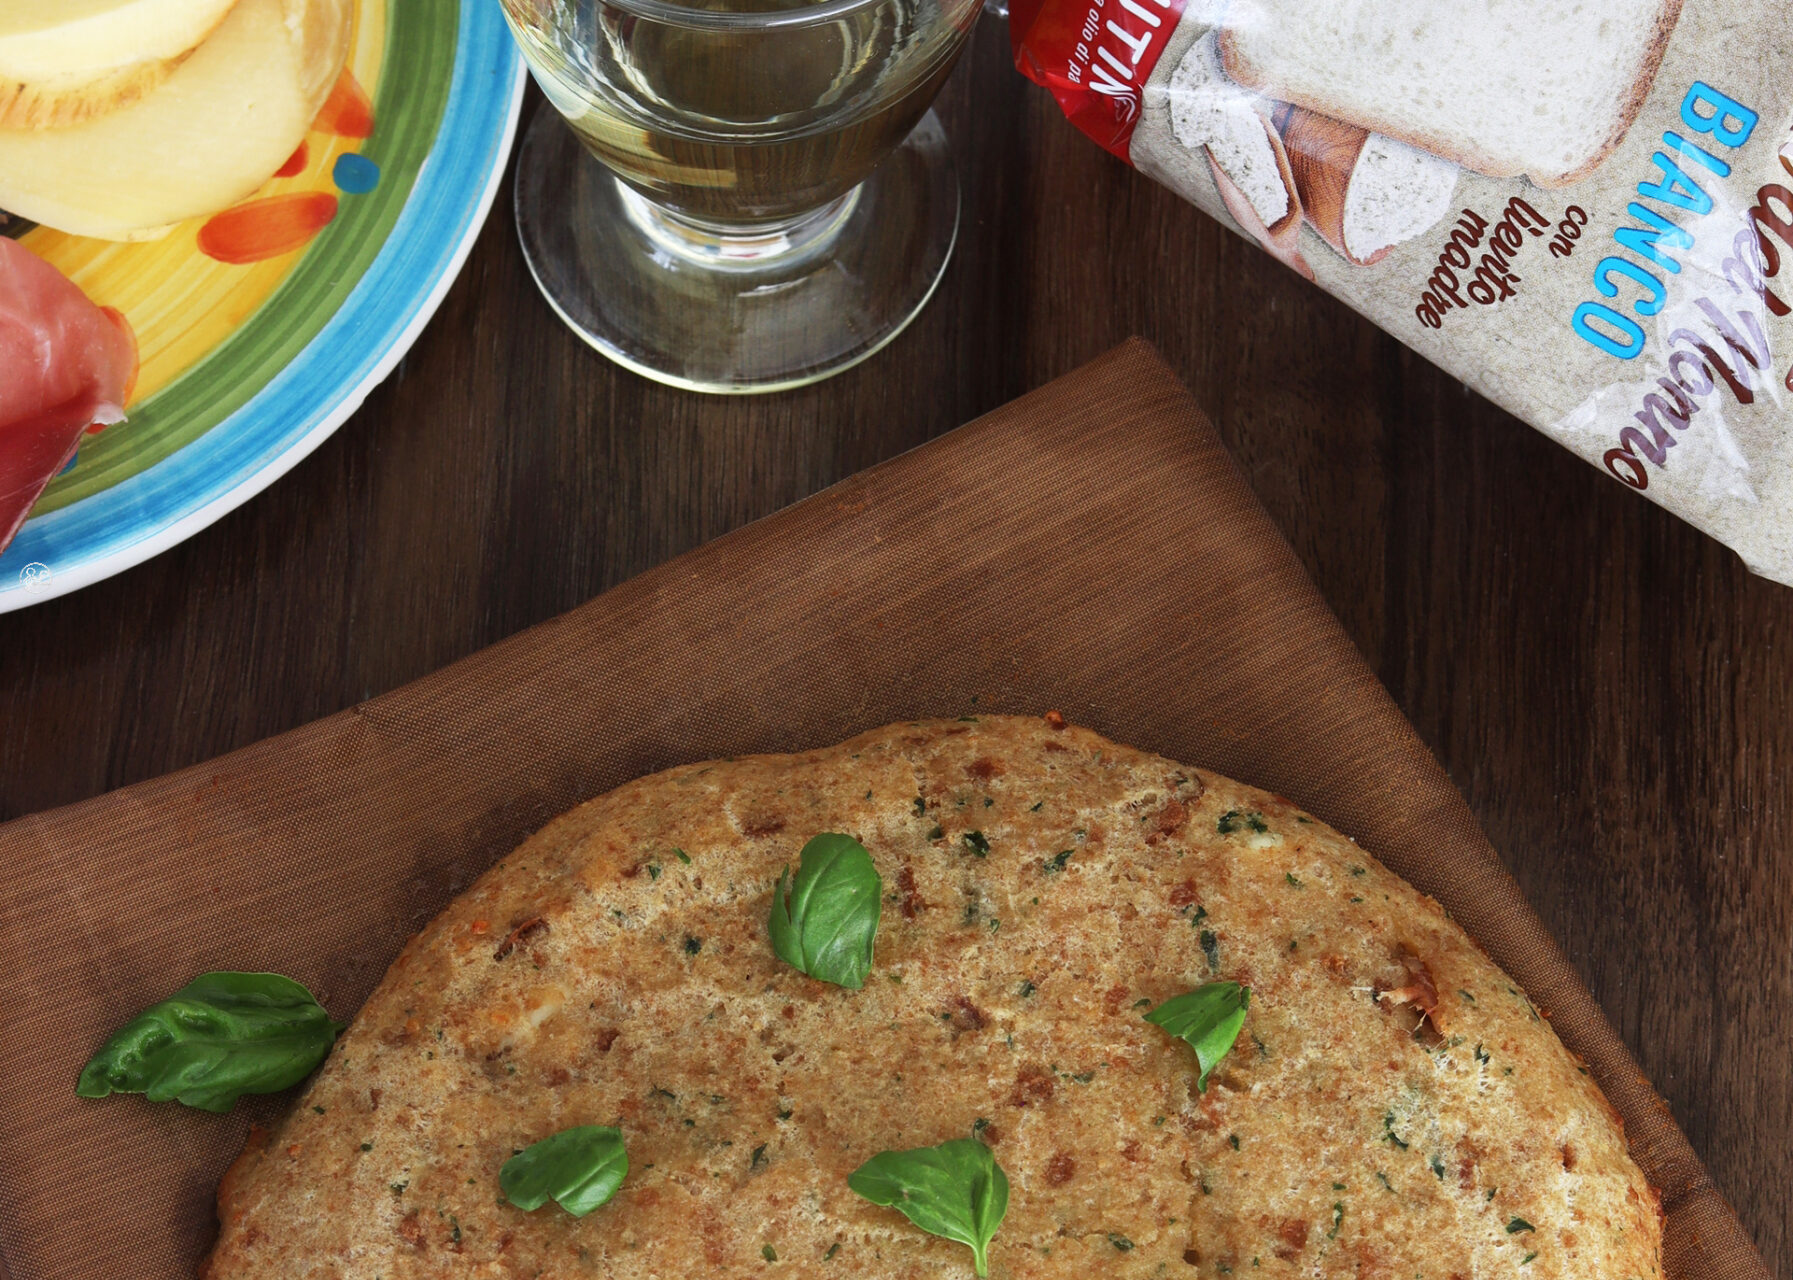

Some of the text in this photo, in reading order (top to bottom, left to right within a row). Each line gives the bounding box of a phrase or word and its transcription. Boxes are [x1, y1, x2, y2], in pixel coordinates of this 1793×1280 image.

[1075, 42, 1090, 65] di
[1082, 9, 1100, 41] olio
[1415, 208, 1489, 329] madre
[1467, 197, 1551, 305] lievito
[1548, 205, 1588, 258] con
[1571, 80, 1760, 360] BIANCO
[1603, 297, 1771, 490] Nonno
